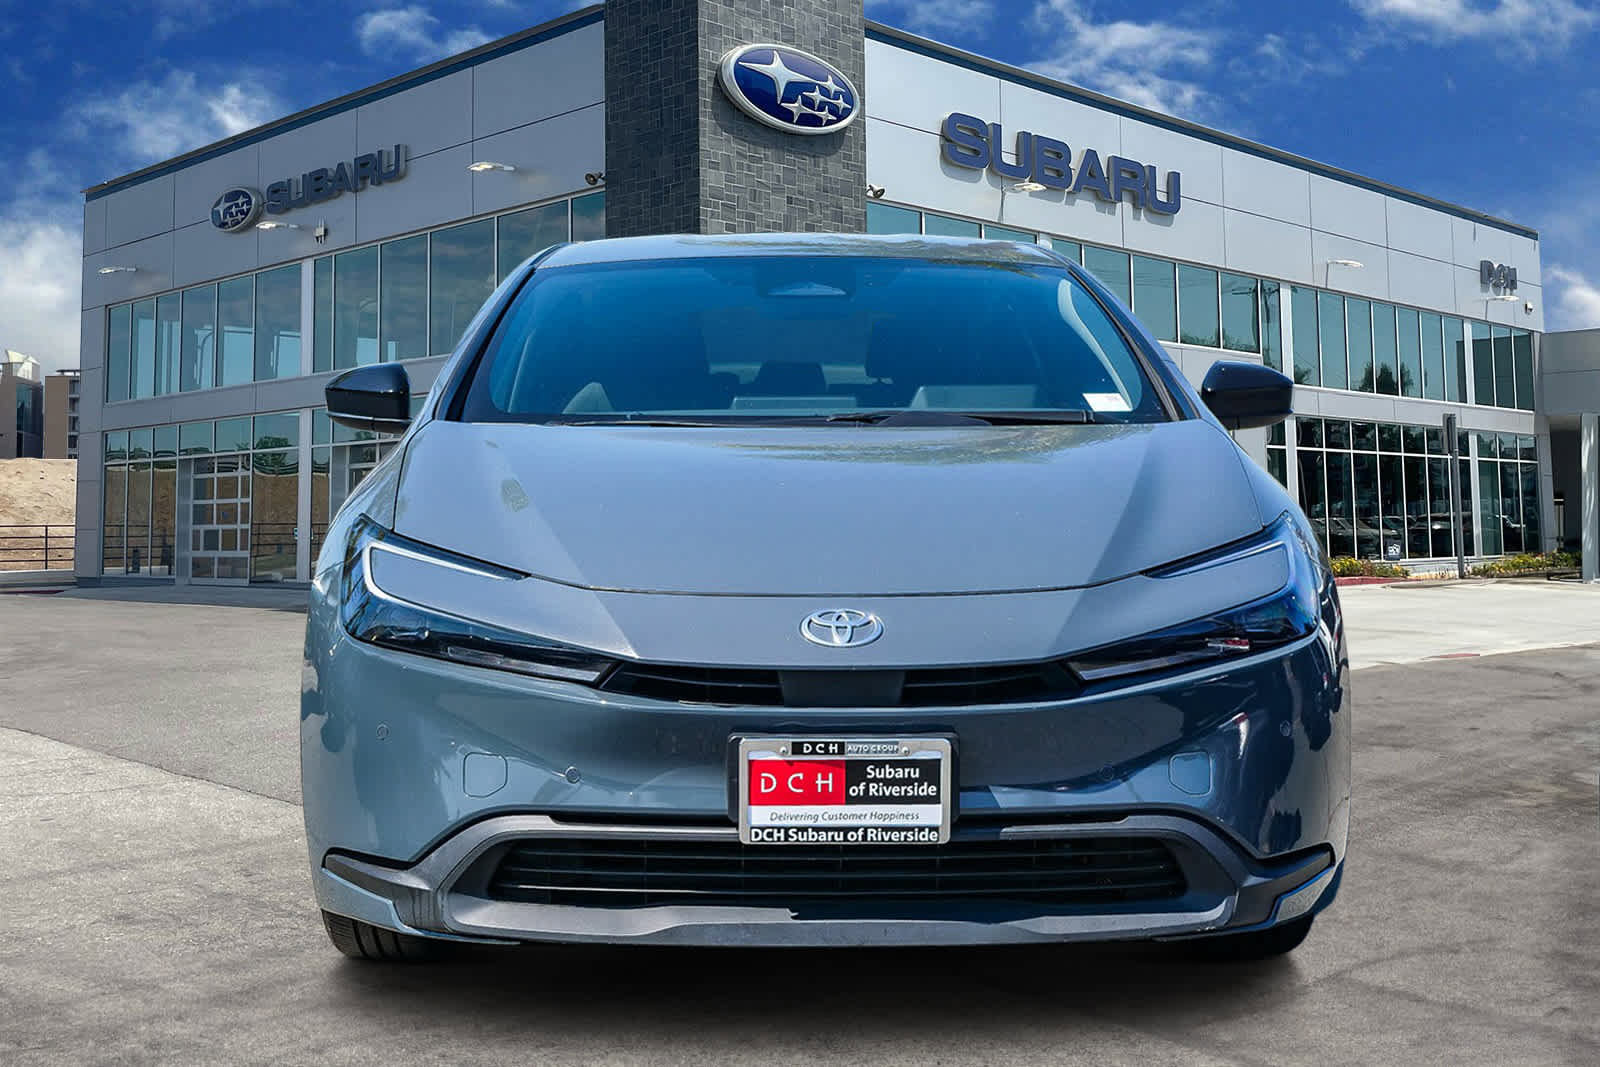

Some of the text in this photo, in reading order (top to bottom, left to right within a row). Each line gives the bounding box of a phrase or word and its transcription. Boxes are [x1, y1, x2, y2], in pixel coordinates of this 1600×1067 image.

[941, 112, 1181, 215] SUBARU
[265, 144, 408, 216] SUBARU
[847, 744, 869, 752] AUTO
[870, 744, 898, 752] GROUP
[866, 765, 920, 779] Subaru
[849, 782, 937, 796] of Riverside
[770, 811, 920, 823] Delivering Customer Happiness
[751, 828, 938, 842] DCH Subaru of Riverside
